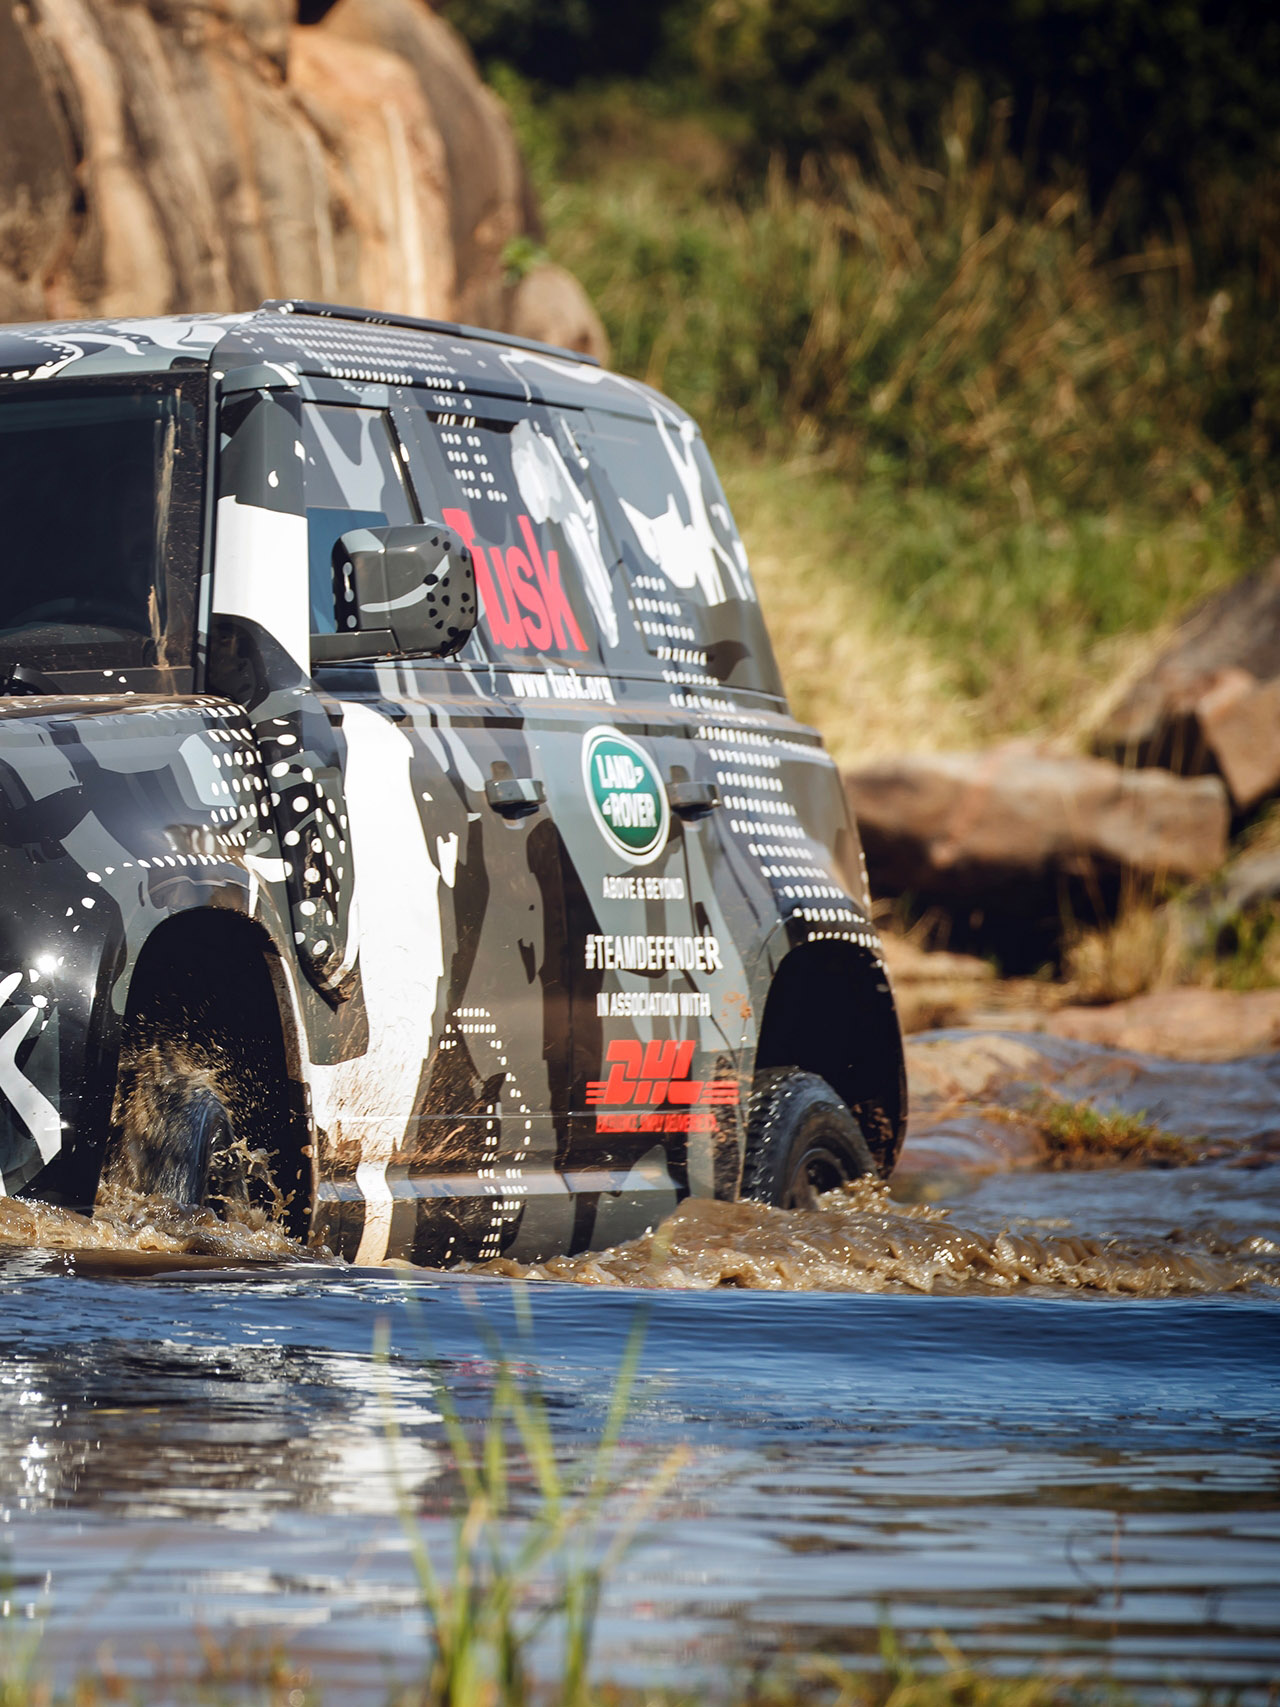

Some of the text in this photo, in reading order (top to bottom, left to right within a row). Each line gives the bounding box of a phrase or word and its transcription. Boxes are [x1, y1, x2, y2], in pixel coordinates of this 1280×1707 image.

[595, 754, 637, 790] LAND
[609, 792, 658, 828] ROVER
[602, 876, 685, 900] ABOVE & BEYOND
[585, 934, 723, 971] #TEAMDEFENDER
[596, 992, 712, 1017] IN ASSOCIATION WITH
[602, 1039, 705, 1105] DHL
